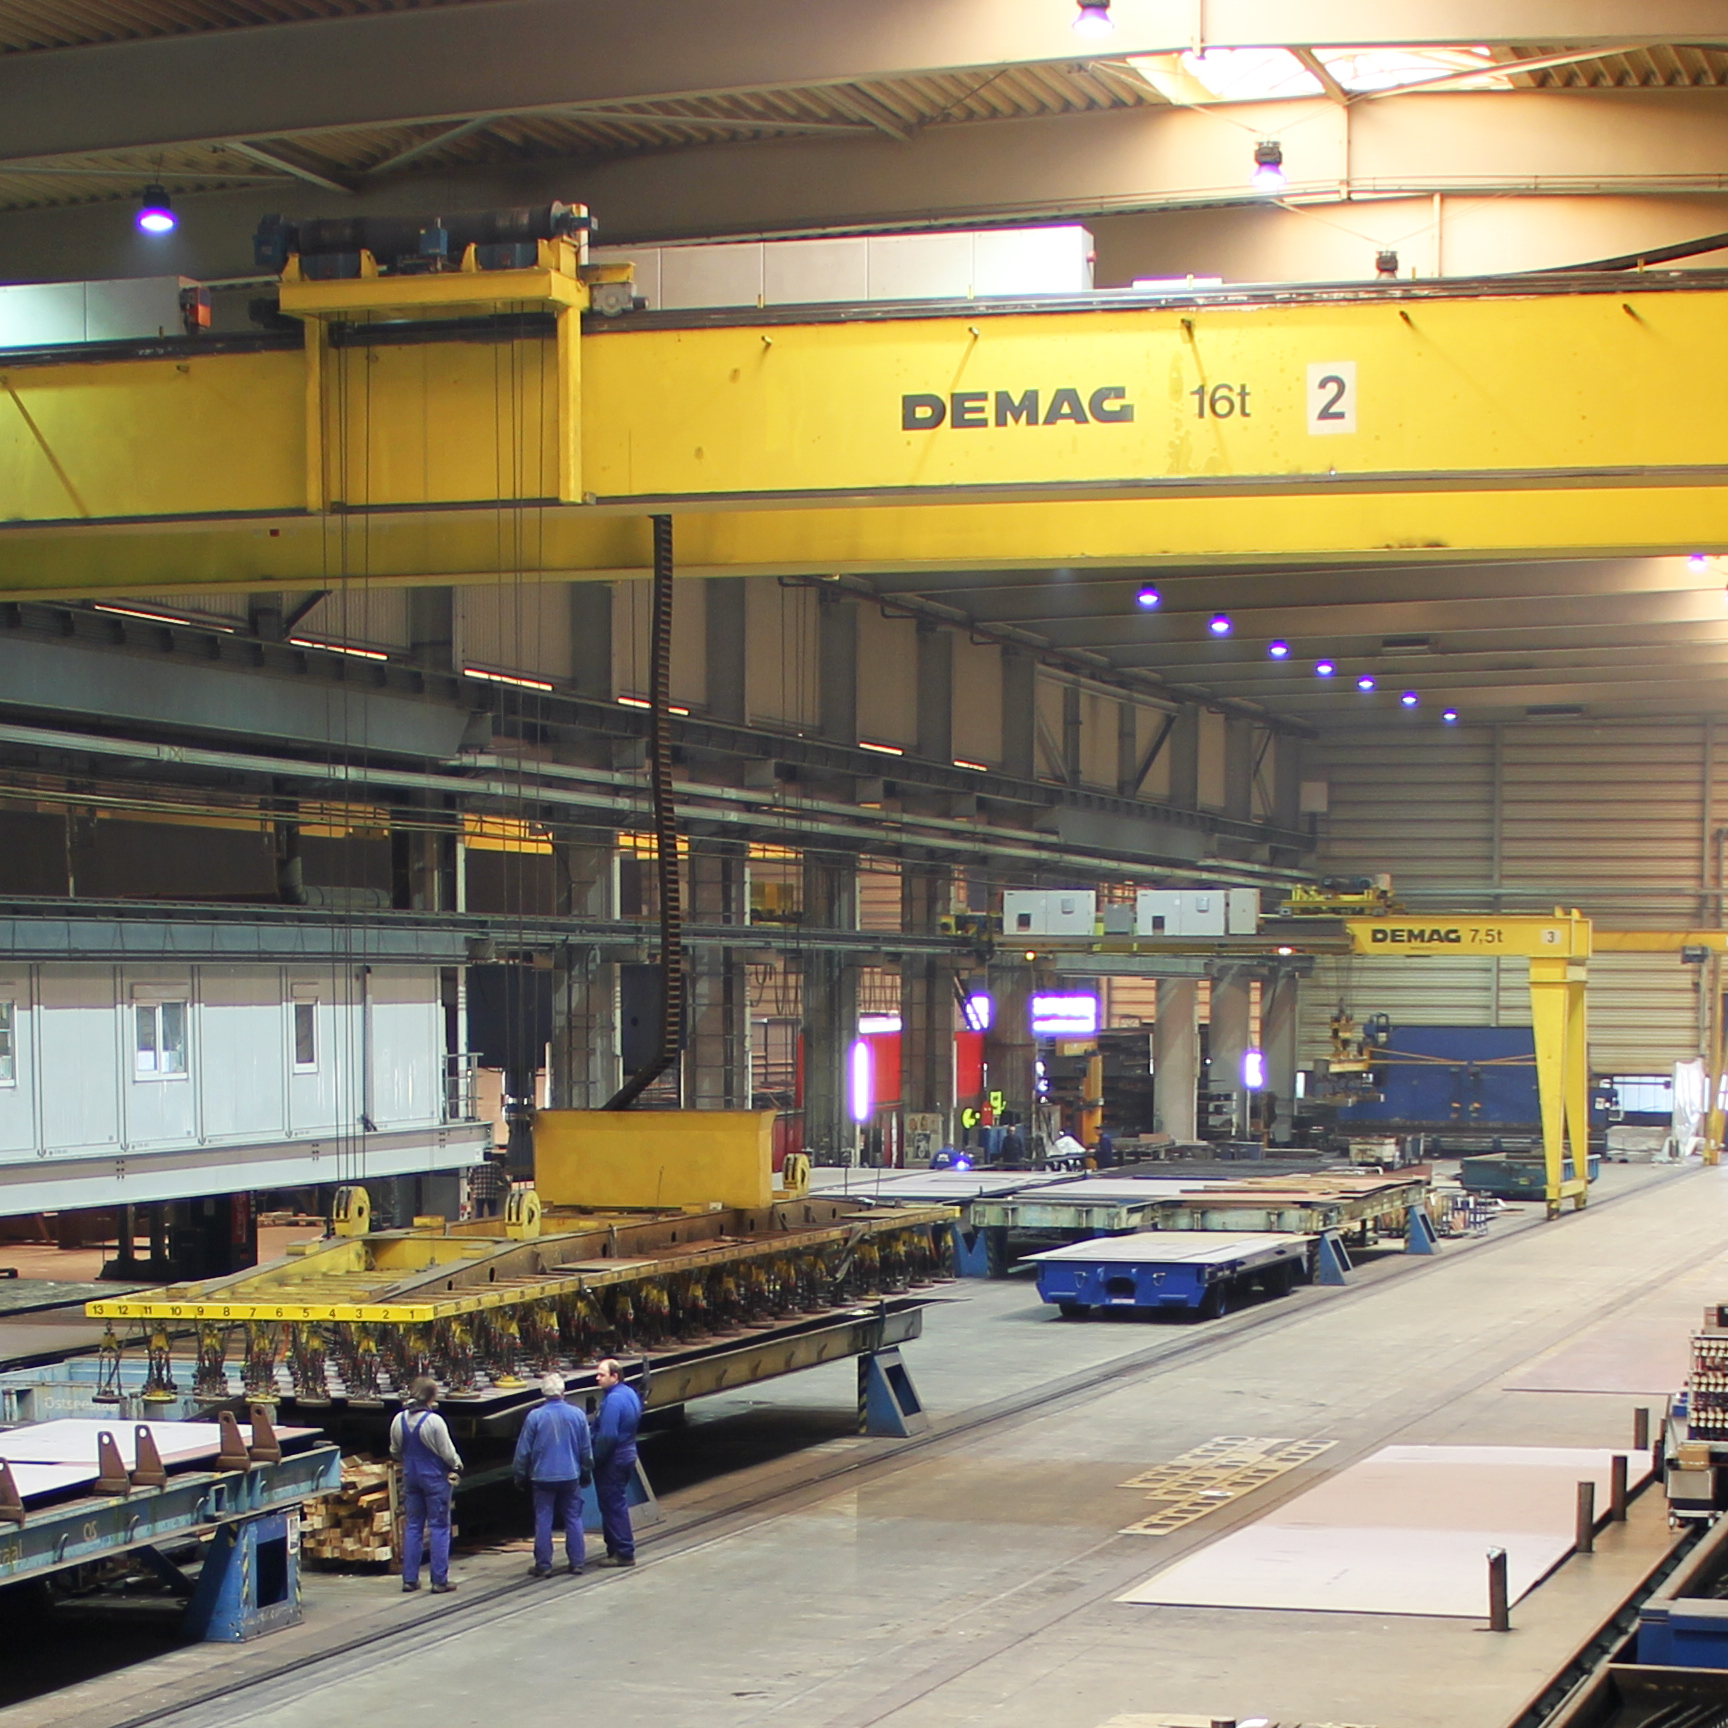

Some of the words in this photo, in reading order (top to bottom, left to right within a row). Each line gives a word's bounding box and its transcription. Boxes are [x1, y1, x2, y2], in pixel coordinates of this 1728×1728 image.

[1316, 375, 1346, 421] 2
[901, 386, 1134, 431] DEMAG
[1190, 383, 1251, 419] 16t
[1371, 928, 1461, 944] DEMAG
[1547, 931, 1556, 944] 3
[92, 1305, 104, 1316] 13
[117, 1305, 129, 1316] 12
[143, 1305, 153, 1315] 11
[170, 1305, 182, 1316] 10
[196, 1306, 204, 1316] 9
[222, 1307, 230, 1317] 8
[249, 1307, 257, 1318] 7
[275, 1307, 283, 1318] 6
[302, 1308, 310, 1319] 5
[328, 1308, 336, 1319] 4
[355, 1308, 363, 1319] 3
[382, 1309, 390, 1320] 2
